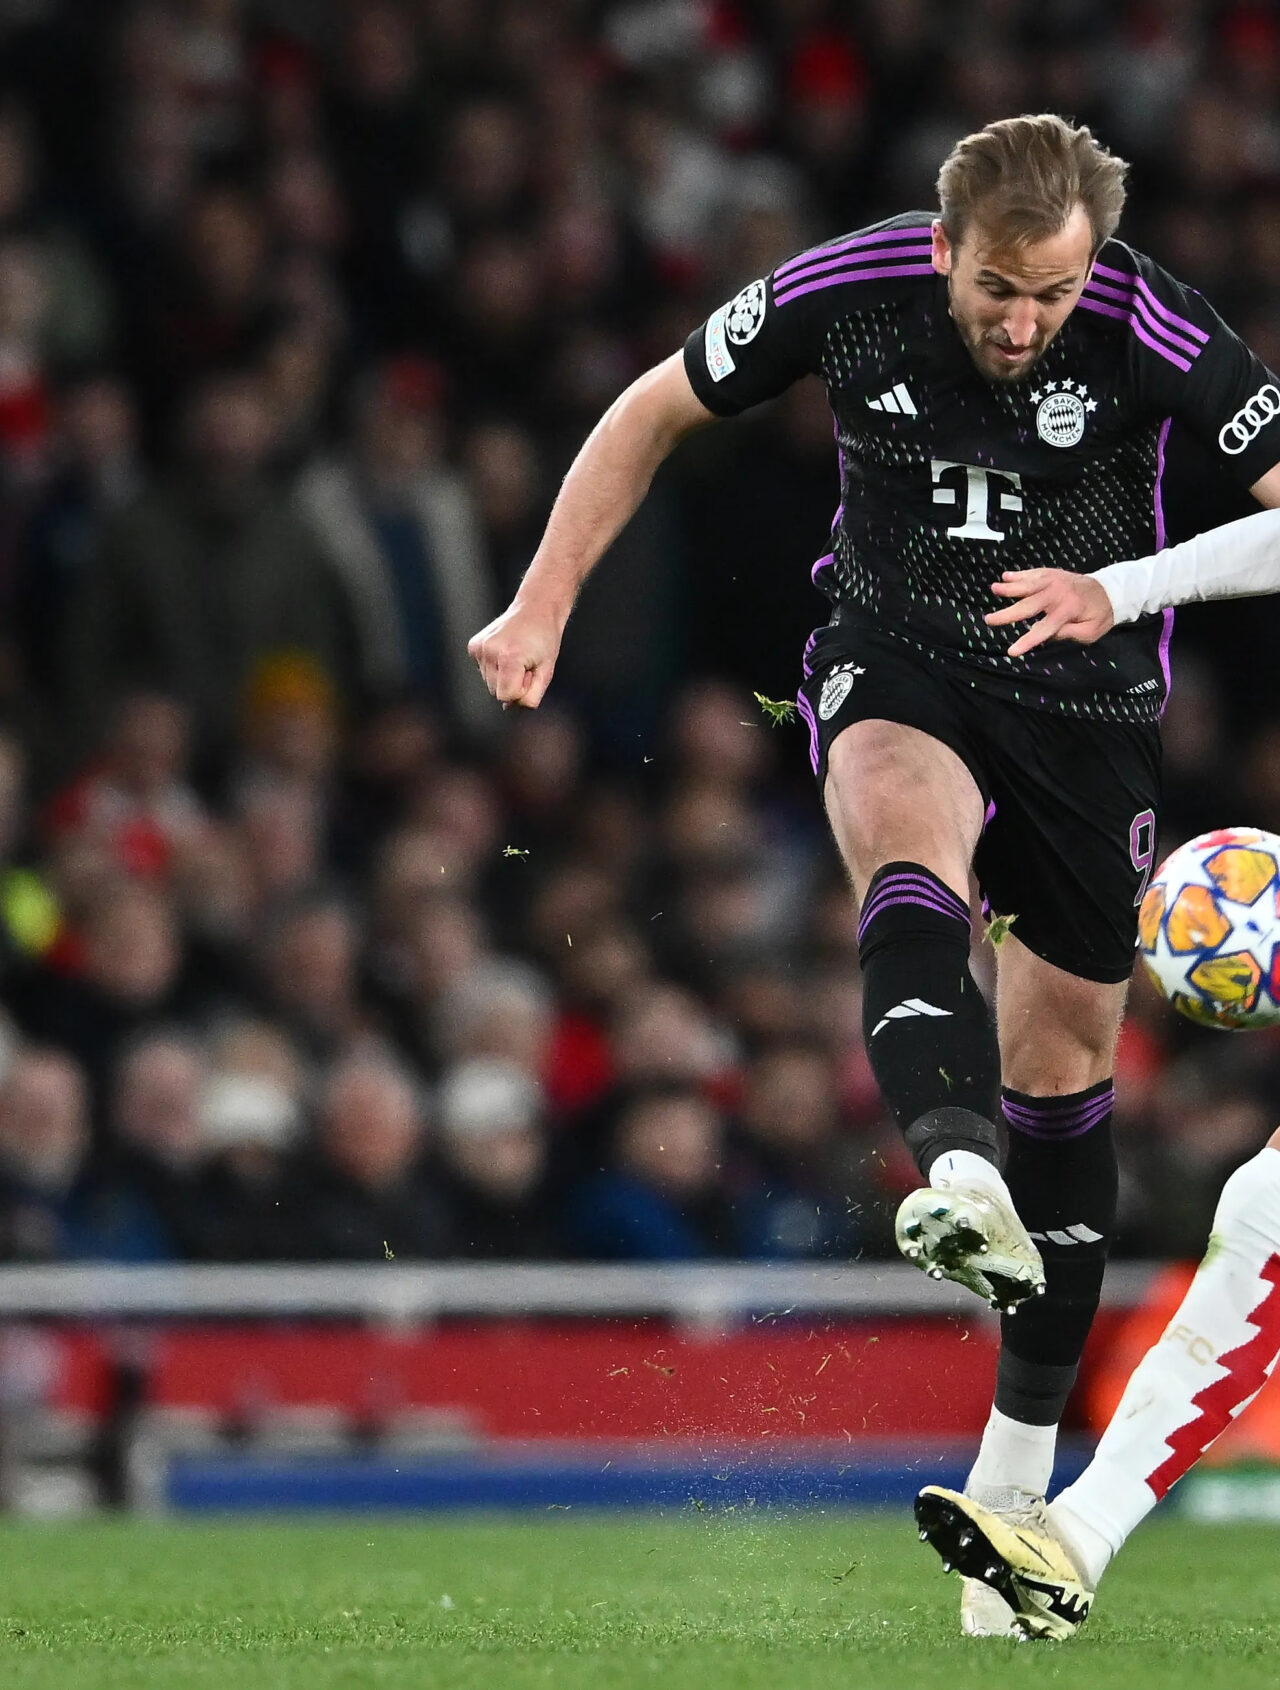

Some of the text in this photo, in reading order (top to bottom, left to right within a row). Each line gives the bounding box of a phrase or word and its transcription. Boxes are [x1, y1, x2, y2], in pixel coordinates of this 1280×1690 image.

[1043, 398, 1082, 418] FC BAYERN
[1129, 808, 1155, 907] 9
[1166, 1325, 1215, 1366] FC
